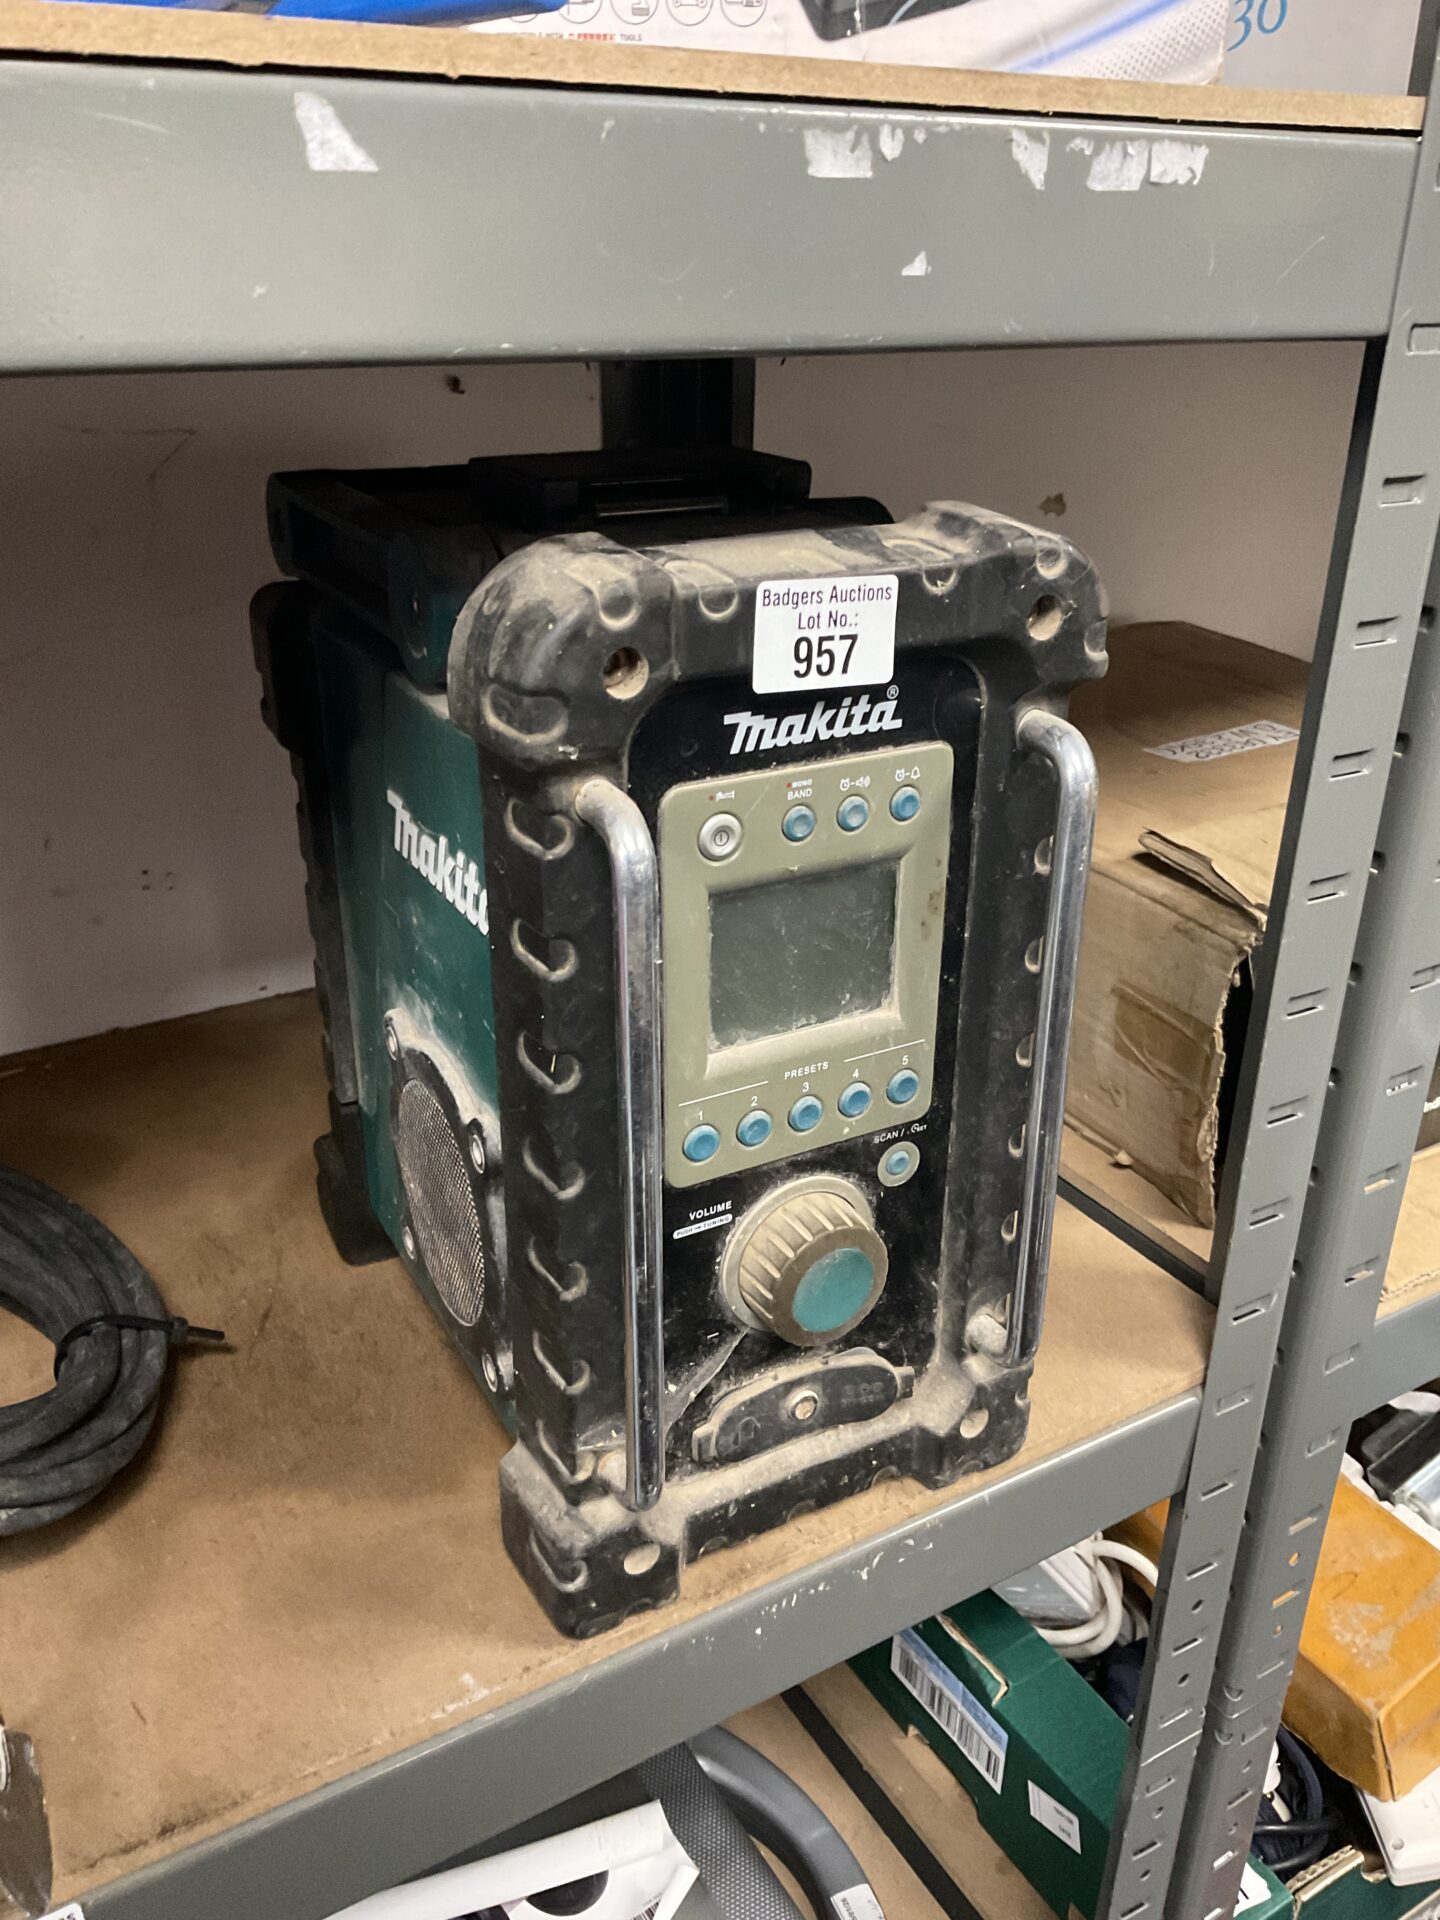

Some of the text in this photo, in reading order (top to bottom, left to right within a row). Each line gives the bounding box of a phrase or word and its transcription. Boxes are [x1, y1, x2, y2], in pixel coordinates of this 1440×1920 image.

[1227, 0, 1288, 51] 30
[620, 33, 642, 41] TOOLS
[762, 584, 892, 609] Badgers Auctions
[798, 610, 859, 630] Lot No.:
[793, 633, 859, 679] 957
[792, 778, 813, 788] MONO
[787, 788, 813, 800] BAND
[784, 1061, 829, 1080] PRESETS
[698, 1055, 909, 1121] 1 2 3 4 5
[873, 1130, 899, 1144] SCAN
[689, 1200, 732, 1220] VOLUME
[676, 1216, 730, 1237] PUSH TUNING
